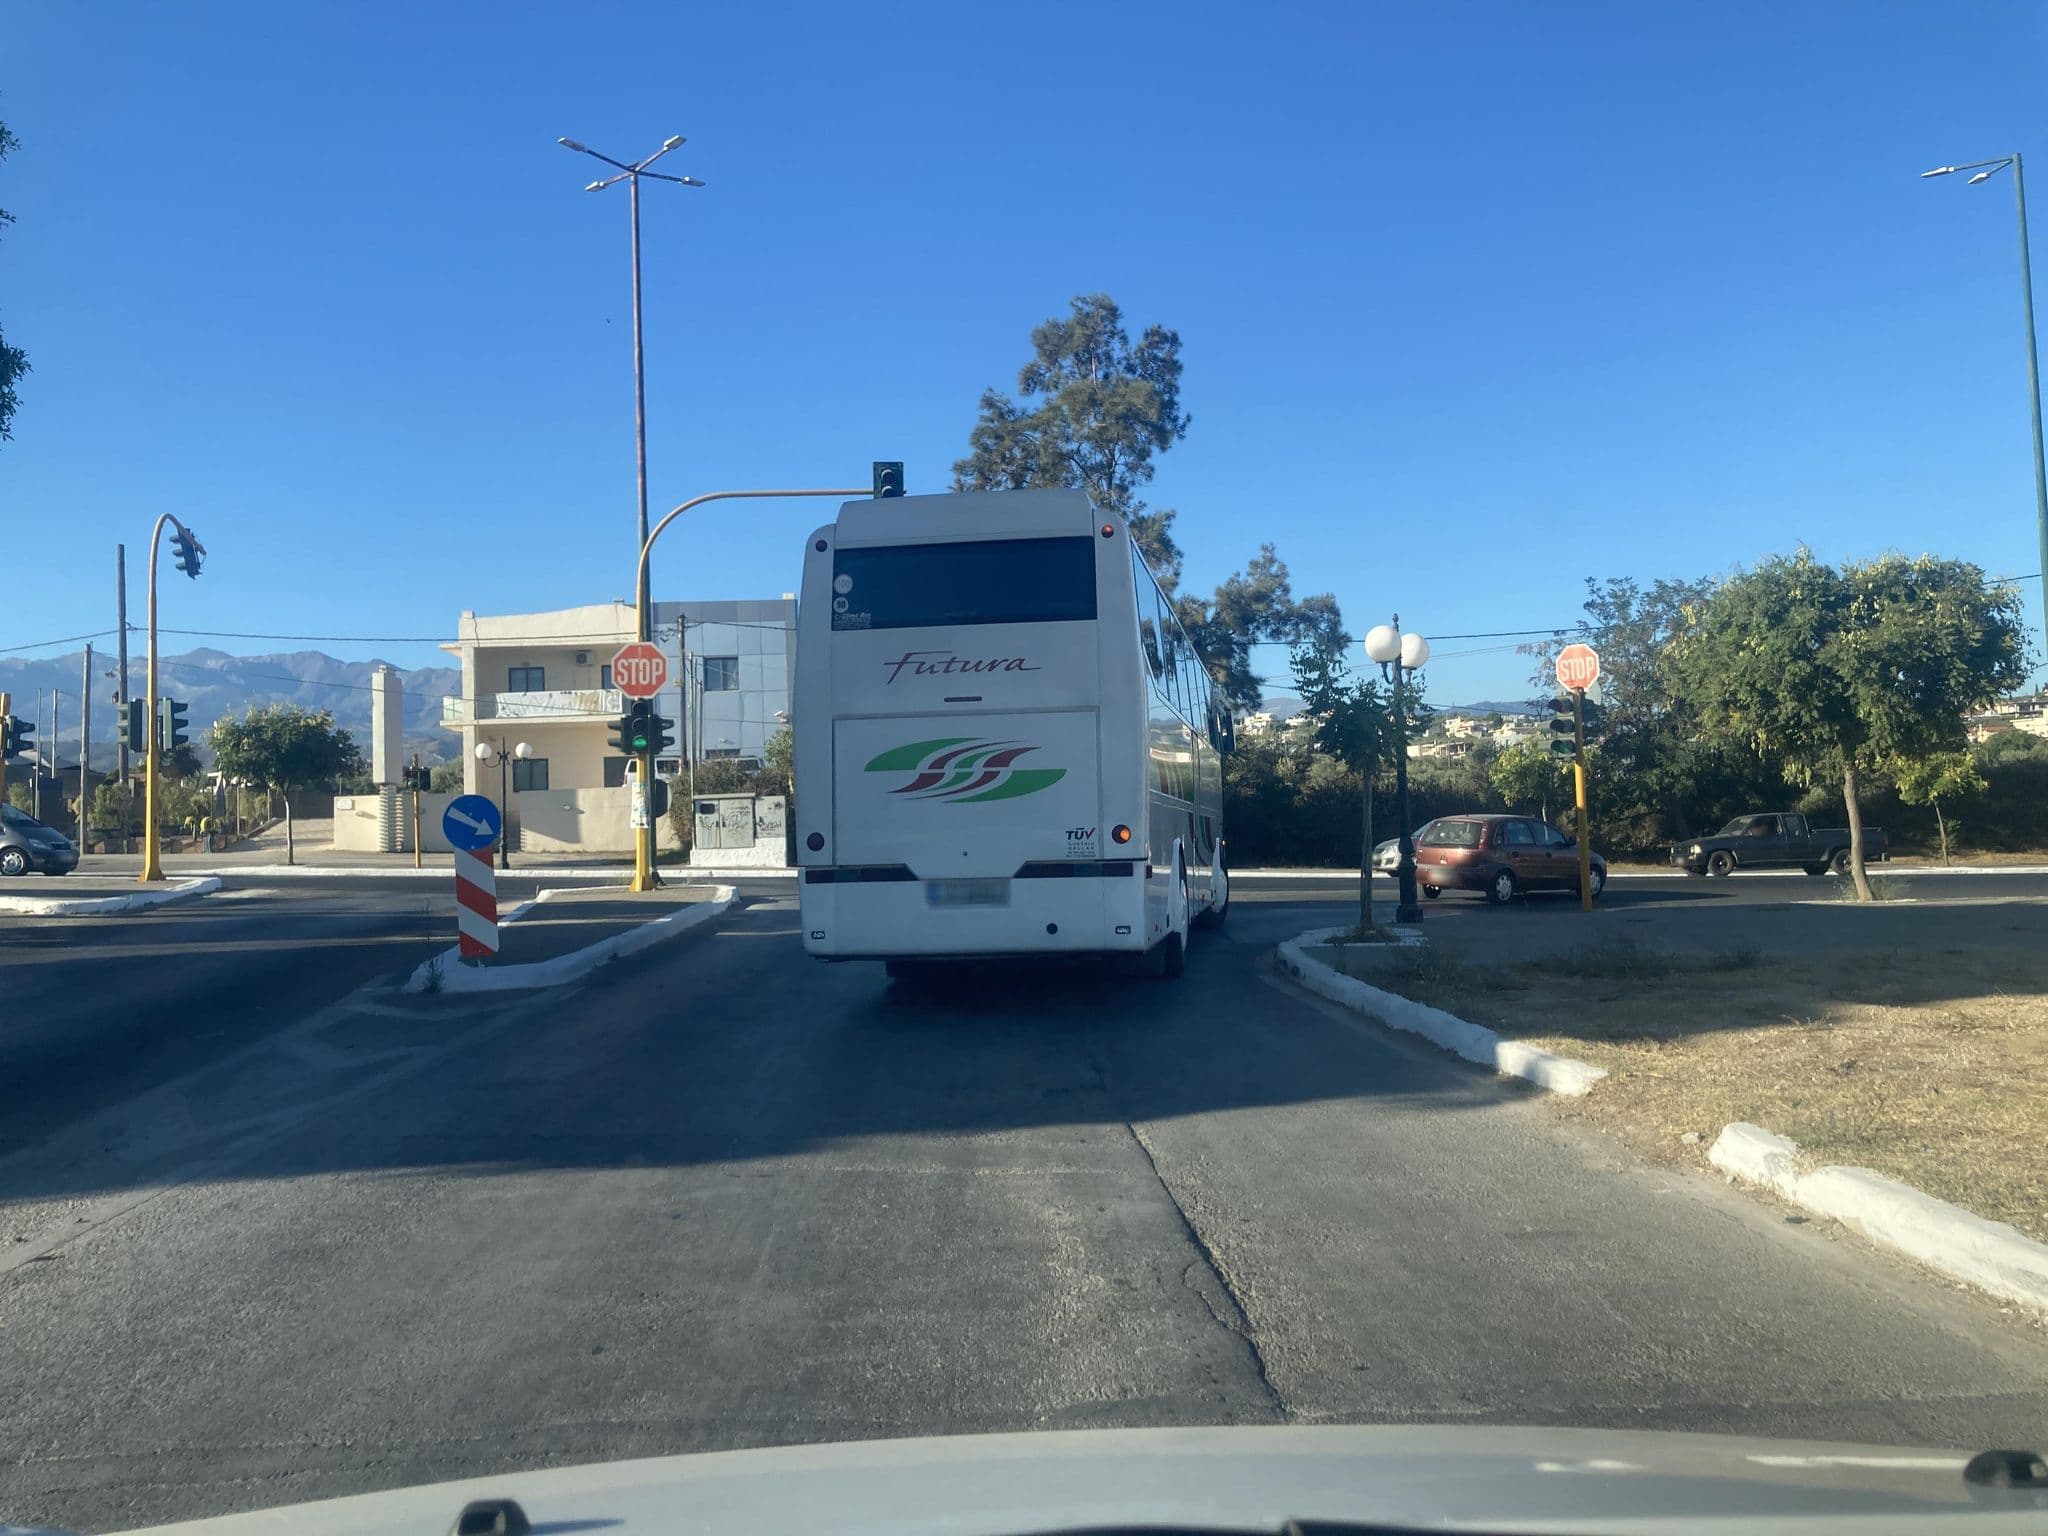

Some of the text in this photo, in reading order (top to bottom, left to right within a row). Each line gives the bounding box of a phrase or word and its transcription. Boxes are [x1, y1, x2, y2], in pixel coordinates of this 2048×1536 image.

[617, 658, 663, 686] STOP
[883, 650, 1041, 685] Futura
[1560, 656, 1595, 681] STOP
